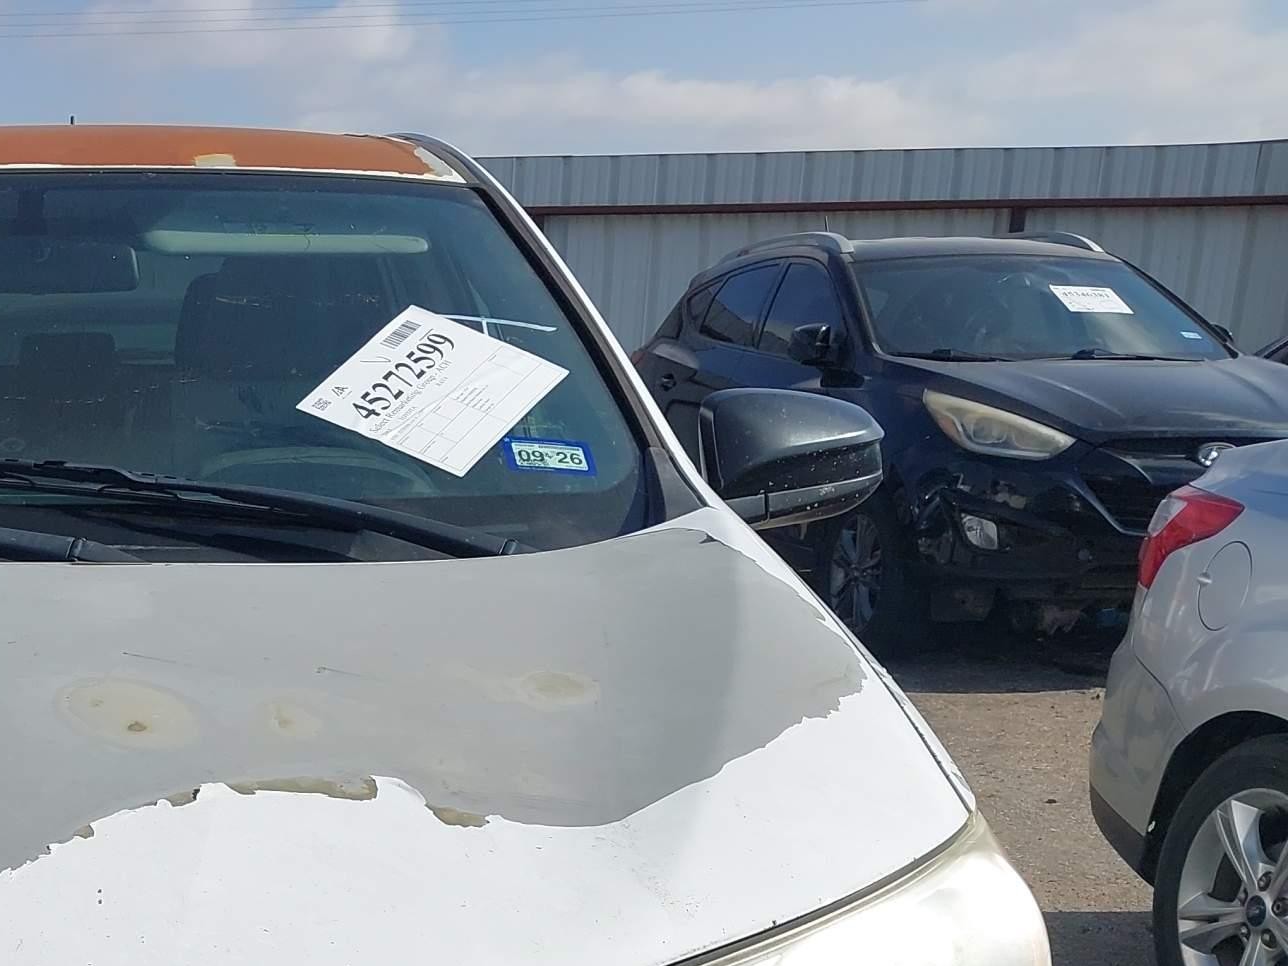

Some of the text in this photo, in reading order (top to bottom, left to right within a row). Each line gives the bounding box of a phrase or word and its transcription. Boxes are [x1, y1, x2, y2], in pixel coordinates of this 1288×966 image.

[352, 333, 455, 419] 45272599
[517, 449, 583, 465] 09 26
